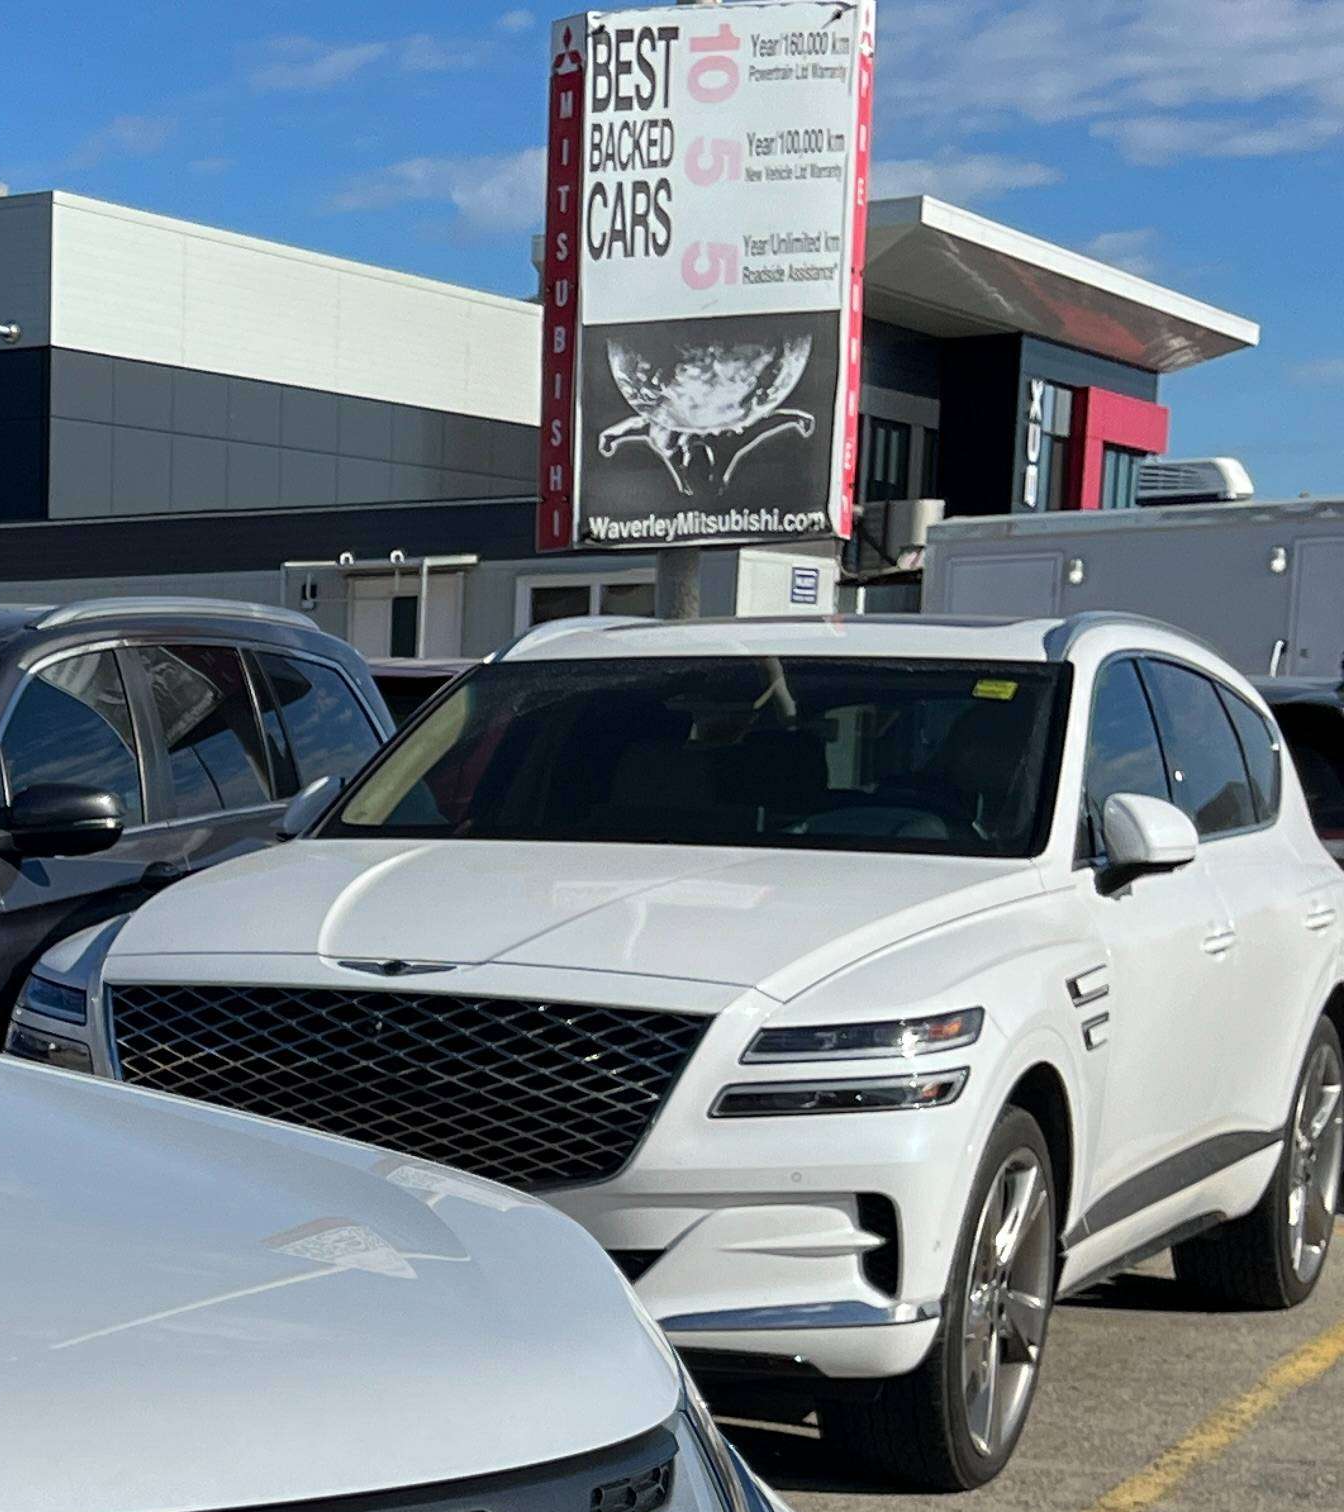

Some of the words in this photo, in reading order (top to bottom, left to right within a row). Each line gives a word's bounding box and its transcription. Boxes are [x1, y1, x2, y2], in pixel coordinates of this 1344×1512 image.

[831, 32, 850, 55] km
[590, 26, 679, 113] BEST
[589, 118, 675, 173] BACKED
[684, 136, 742, 187] 5
[826, 127, 845, 151] km
[587, 178, 673, 261] CARS
[823, 231, 840, 252] km
[681, 241, 738, 290] 5
[549, 90, 573, 536] MITSUBISHI
[588, 508, 827, 542] WaverleyMitsubishi.com
